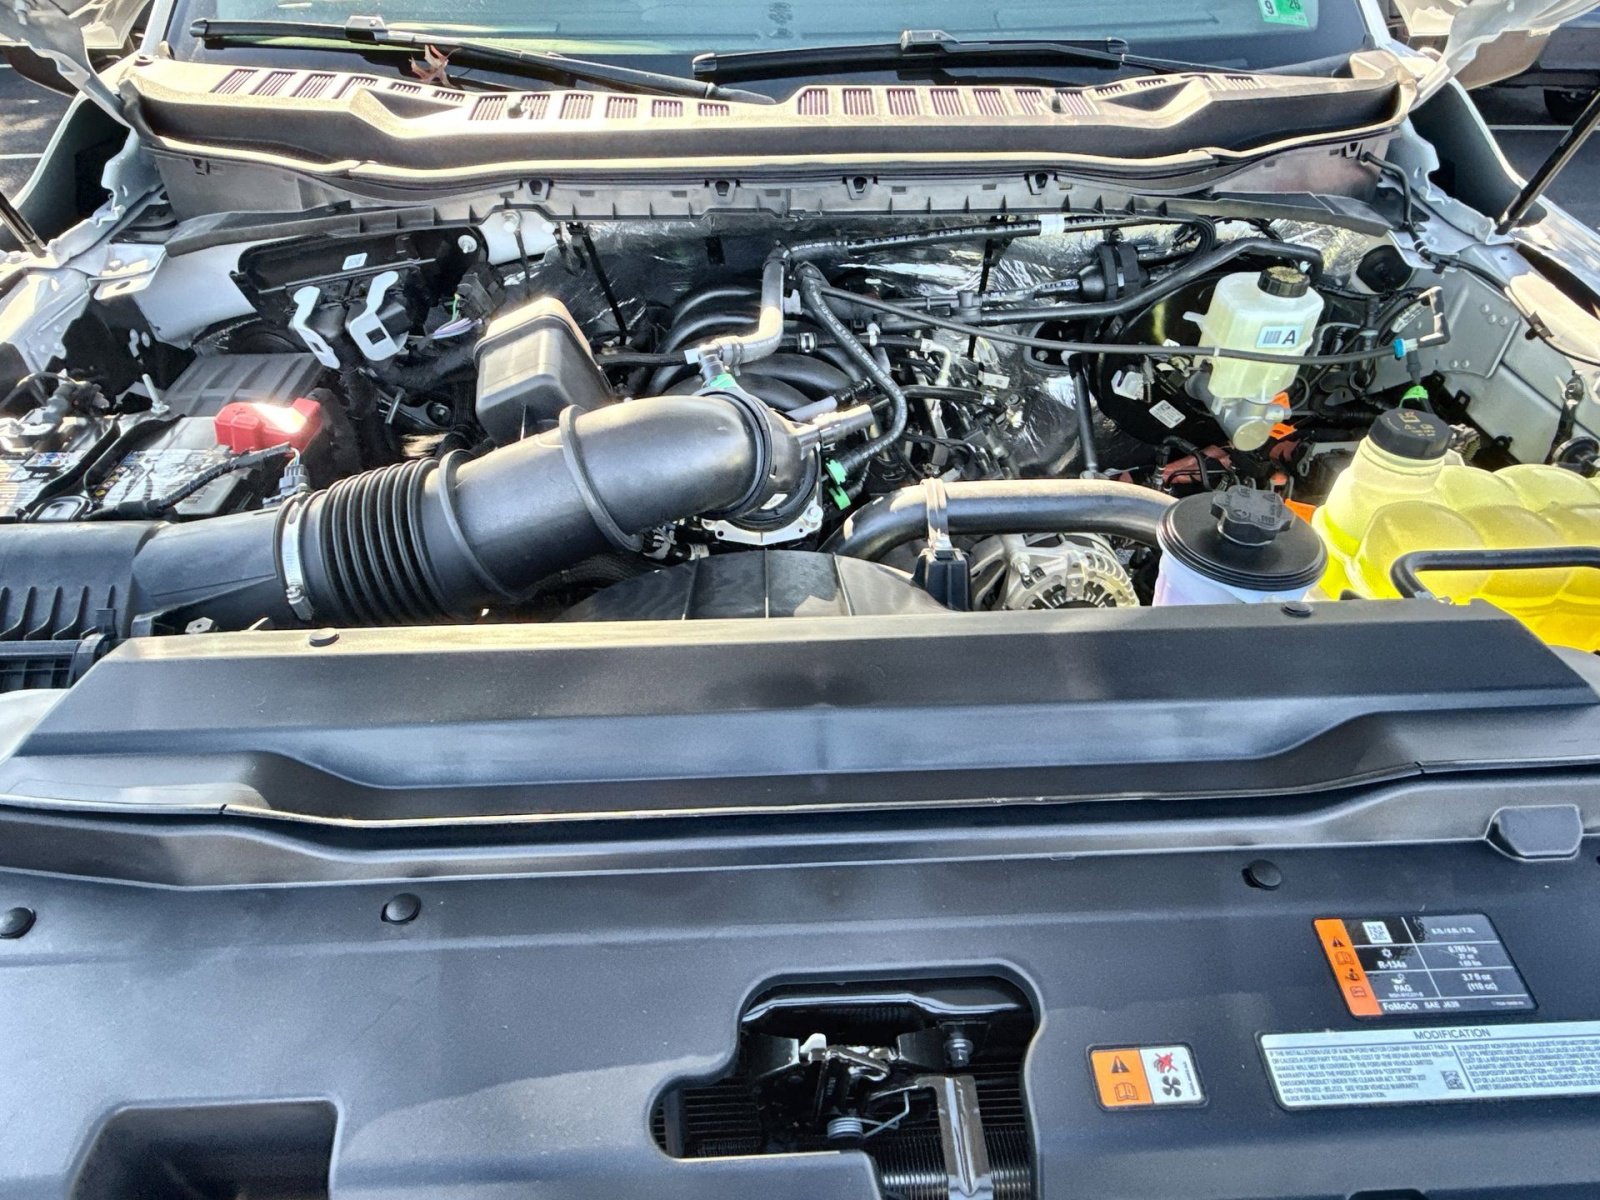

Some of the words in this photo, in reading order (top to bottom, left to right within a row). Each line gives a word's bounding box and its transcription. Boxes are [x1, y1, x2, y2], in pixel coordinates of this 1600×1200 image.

[1281, 330, 1296, 344] A
[1394, 984, 1413, 992] PAG
[1383, 1001, 1418, 1010] FoMoCo
[1414, 1028, 1491, 1039] MODIFICATION
